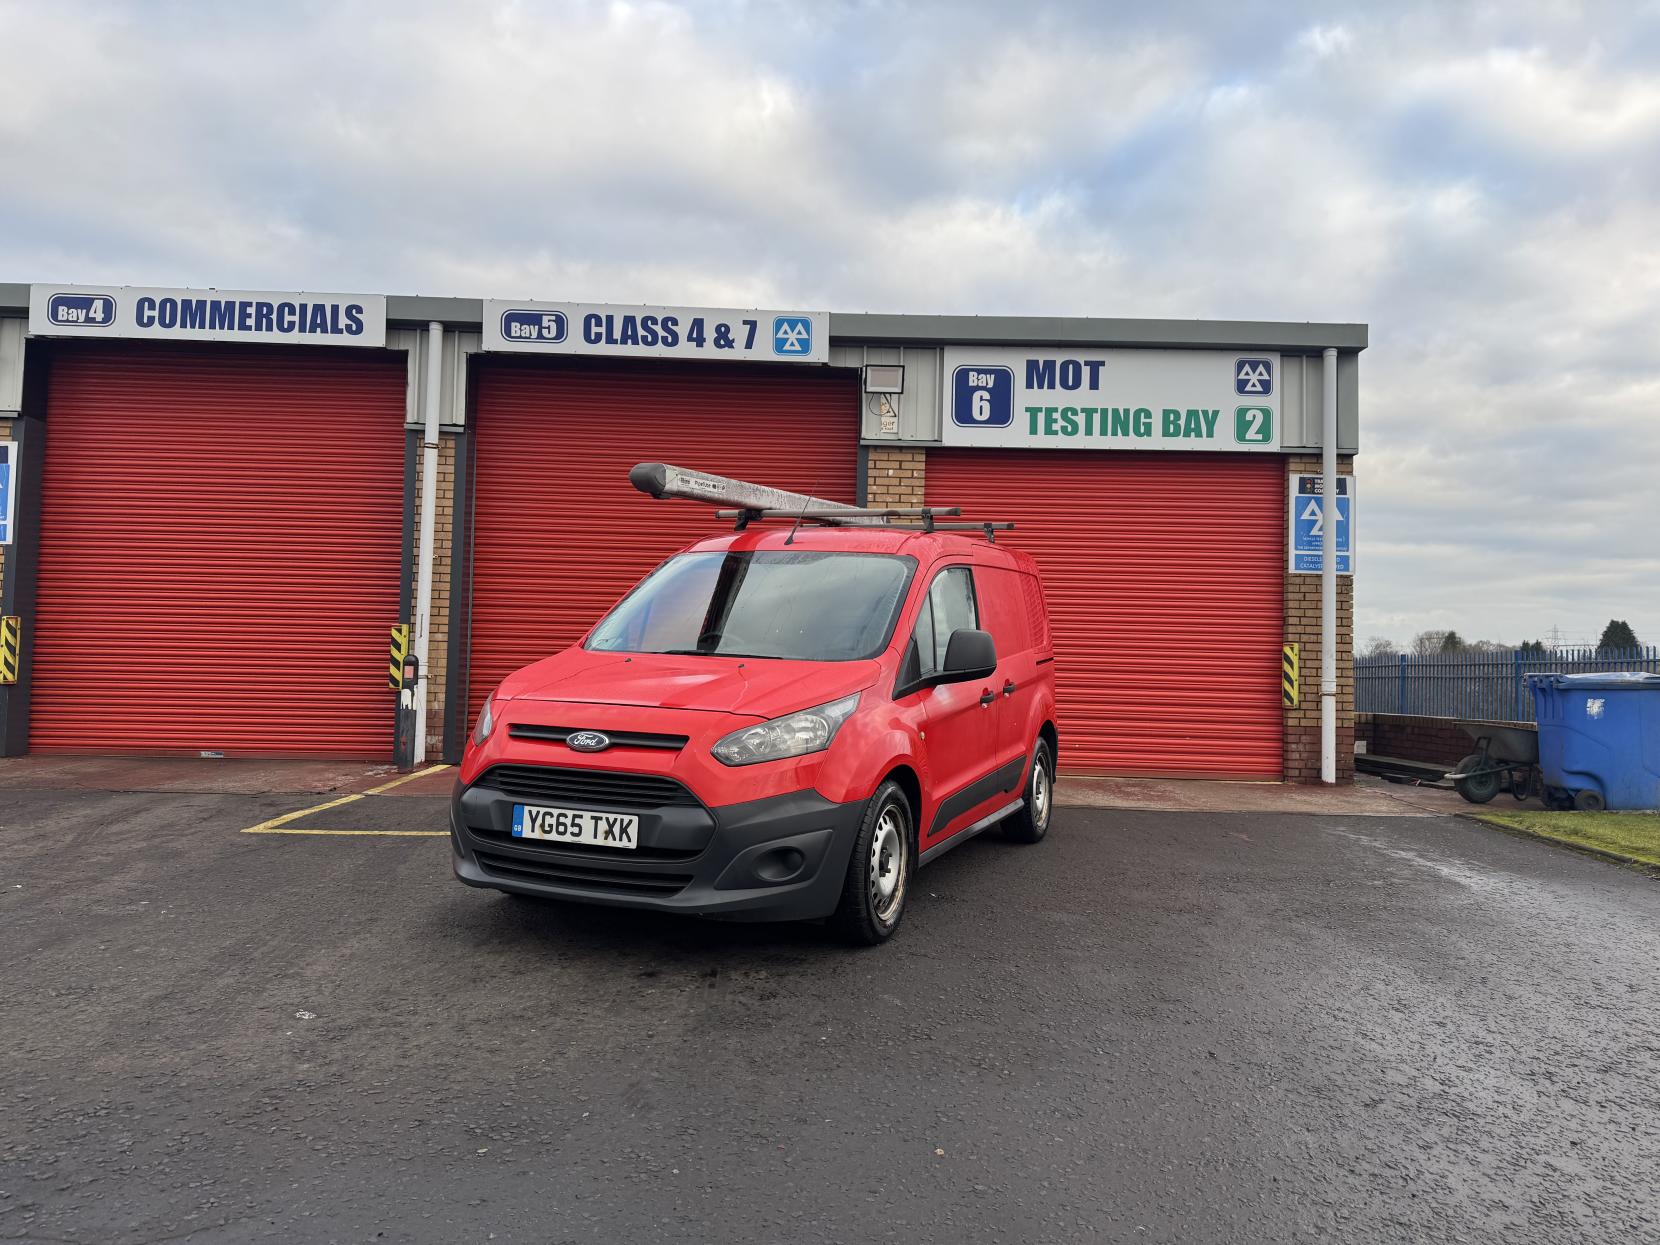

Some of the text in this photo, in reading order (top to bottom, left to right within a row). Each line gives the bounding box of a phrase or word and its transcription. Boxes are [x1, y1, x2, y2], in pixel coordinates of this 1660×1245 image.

[57, 299, 105, 323] Bay 4
[135, 296, 364, 336] COMMERCIALS
[510, 315, 557, 339] Bay 5
[583, 313, 758, 350] CLASS 4 & 7
[968, 371, 995, 389] Bay
[1025, 359, 1106, 391] MOT
[971, 390, 991, 422] 6
[1024, 406, 1264, 441] TESTING BAY 2
[574, 733, 599, 746] Ford
[528, 809, 634, 843] YG65 TXK
